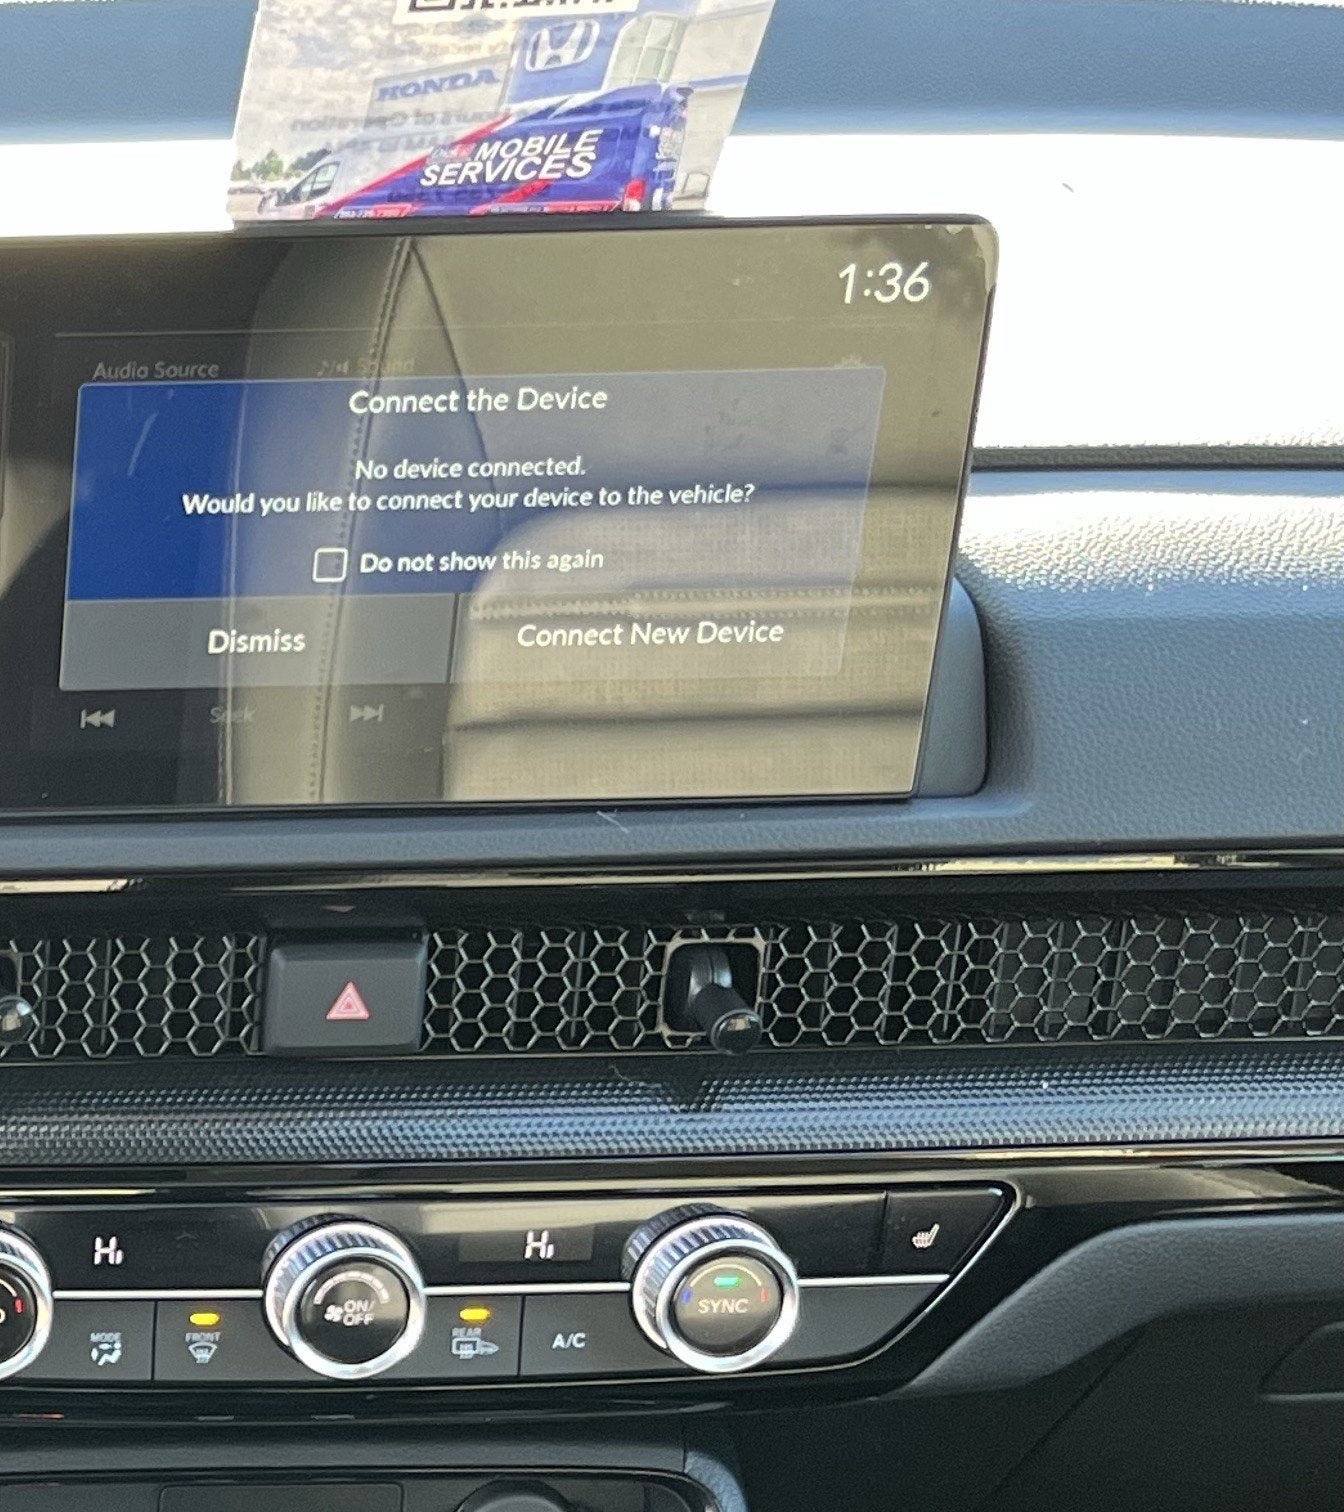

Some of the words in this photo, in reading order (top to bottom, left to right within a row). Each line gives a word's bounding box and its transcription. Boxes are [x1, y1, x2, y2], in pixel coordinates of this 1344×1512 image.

[376, 68, 500, 103] HONDA
[475, 129, 604, 161] MOBILE
[420, 152, 596, 188] SERVICES
[838, 261, 932, 304] 1:36
[93, 361, 148, 380] Audio
[154, 360, 220, 379] Source
[349, 390, 458, 415] Connect
[467, 388, 509, 412] the
[517, 387, 607, 411] Device
[355, 460, 386, 479] No
[393, 458, 462, 479] device
[467, 456, 586, 478] connected.
[182, 492, 255, 515] Would
[261, 495, 301, 522] you
[306, 492, 343, 513] like
[348, 493, 371, 512] to
[376, 490, 464, 512] connect
[469, 490, 519, 517] your
[524, 485, 595, 509] device
[599, 487, 622, 507] to
[628, 484, 663, 506] the
[667, 483, 754, 505] vehicle?
[359, 553, 392, 574] Do
[397, 552, 434, 573] not
[439, 552, 496, 572] show
[502, 550, 542, 571] this
[547, 550, 604, 576] again
[208, 628, 306, 655] Dismiss
[517, 623, 622, 648] Connect
[629, 621, 690, 646] New
[696, 620, 784, 644] Device
[342, 1312, 375, 1327] OFF
[697, 1299, 750, 1315] SYNC
[551, 1332, 587, 1350] A/C
